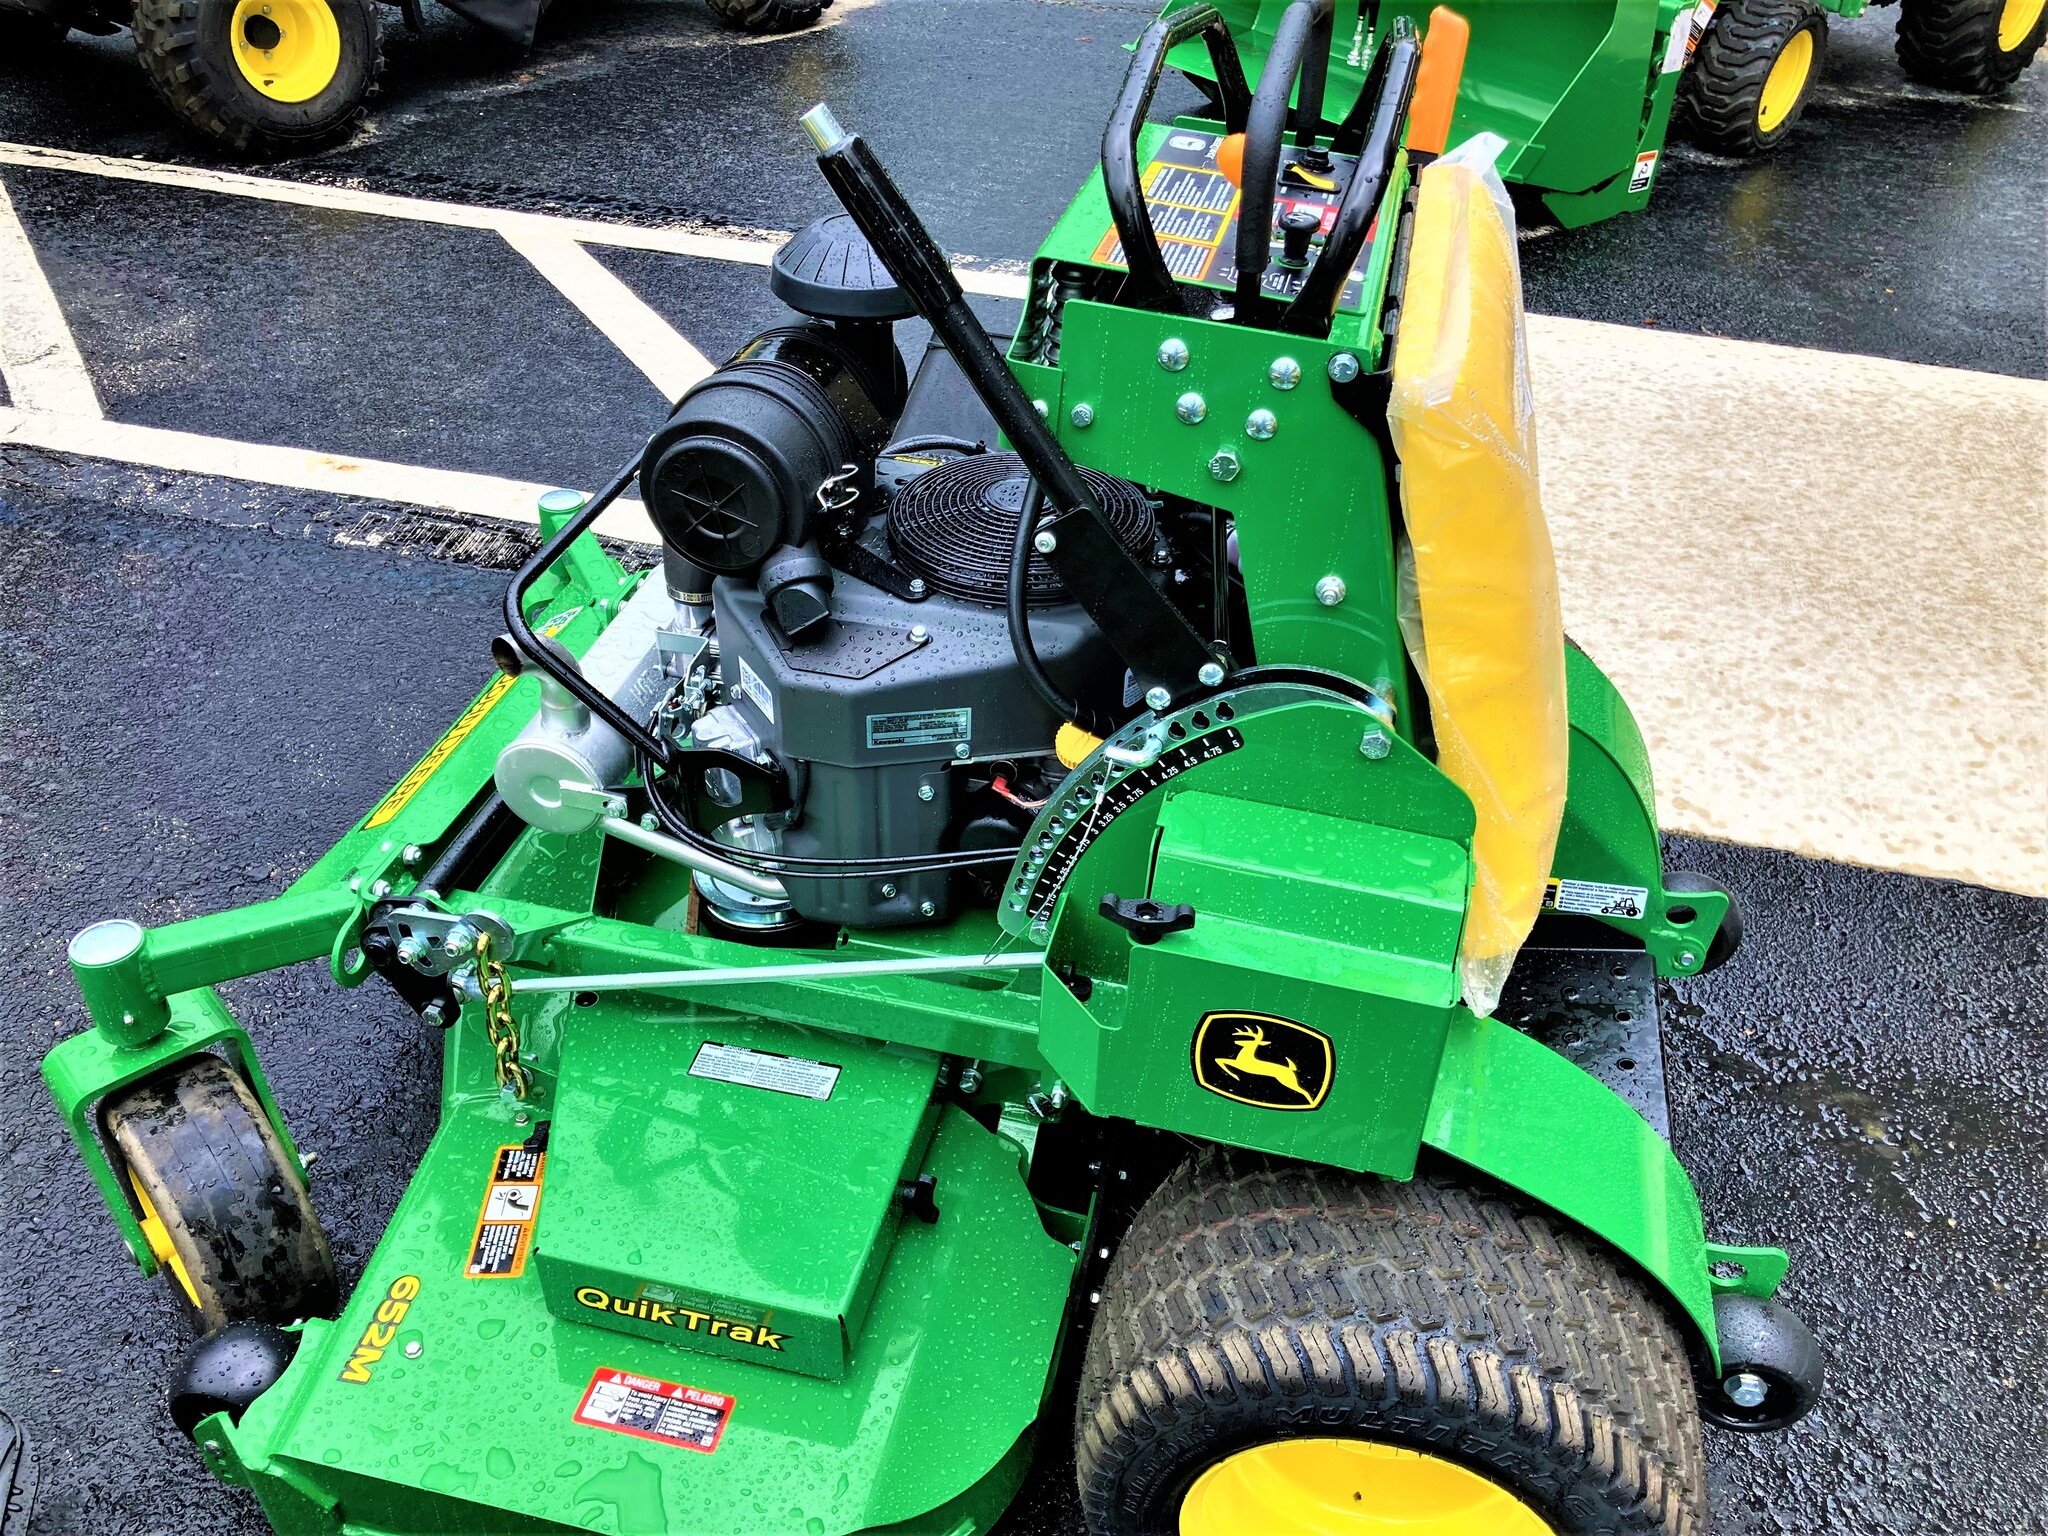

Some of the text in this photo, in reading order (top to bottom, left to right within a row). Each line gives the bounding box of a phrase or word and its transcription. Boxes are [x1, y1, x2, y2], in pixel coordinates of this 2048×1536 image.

[377, 732, 467, 815] DEERE
[1091, 827, 1100, 835] 3
[1098, 812, 1115, 828] 3.25
[1113, 801, 1127, 814] 3.5
[1127, 787, 1145, 803] 3.75
[1150, 779, 1157, 787] 4
[1161, 766, 1179, 781] 4.25
[1183, 756, 1198, 768] 4.5
[1203, 745, 1223, 760] 4.75
[1232, 740, 1240, 748] 5
[341, 1275, 421, 1383] 652M
[575, 1286, 786, 1351] QuikTrak
[623, 1375, 661, 1392] DANGER
[685, 1389, 725, 1407] PELIGRO
[1273, 1405, 1450, 1442] MULTI
